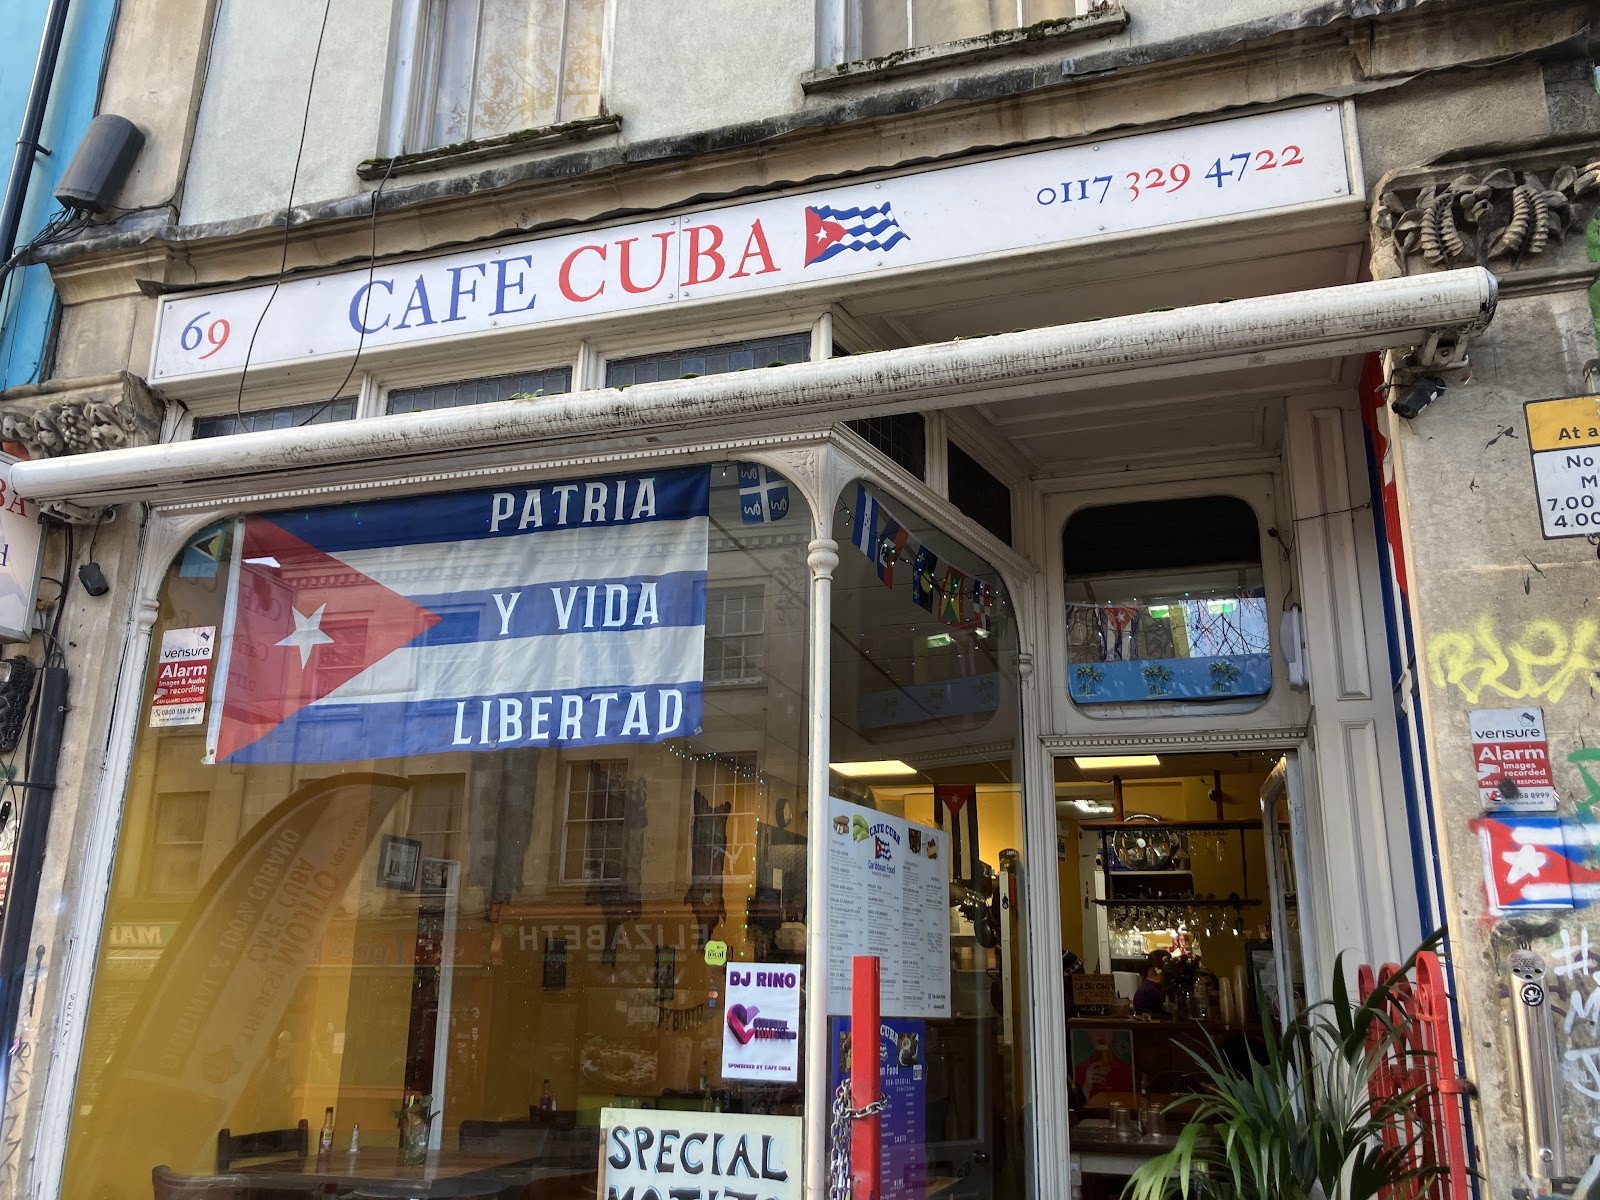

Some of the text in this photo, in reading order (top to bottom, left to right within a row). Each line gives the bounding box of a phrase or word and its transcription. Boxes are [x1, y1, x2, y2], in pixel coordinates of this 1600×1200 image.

[1037, 144, 1305, 205] 0117 329 4722
[349, 217, 781, 335] CAFE CUBA
[180, 311, 230, 360] 69
[1558, 426, 1581, 441] At
[1566, 454, 1594, 469] No
[488, 477, 657, 533] PATRIA
[1547, 494, 1595, 512] 7.00
[492, 581, 660, 636] Y VIDA
[164, 646, 210, 659] verisure
[160, 663, 208, 679] Alarm
[158, 680, 180, 688] Images
[187, 677, 206, 685] Audio
[169, 685, 205, 695] recording
[451, 688, 683, 747] LIBERTAD
[1475, 728, 1540, 739] verisure
[1478, 745, 1545, 761] Alarm
[1503, 762, 1537, 771] Images
[1504, 768, 1546, 777] recorded
[1530, 791, 1550, 799] 8999
[869, 823, 901, 846] CAFE CUBA
[886, 863, 896, 875] Food
[708, 950, 724, 958] local
[729, 970, 797, 989] DJ RINO
[879, 1024, 899, 1047] CUBA
[886, 1063, 899, 1076] Food
[608, 1125, 789, 1184] SPECIAL
